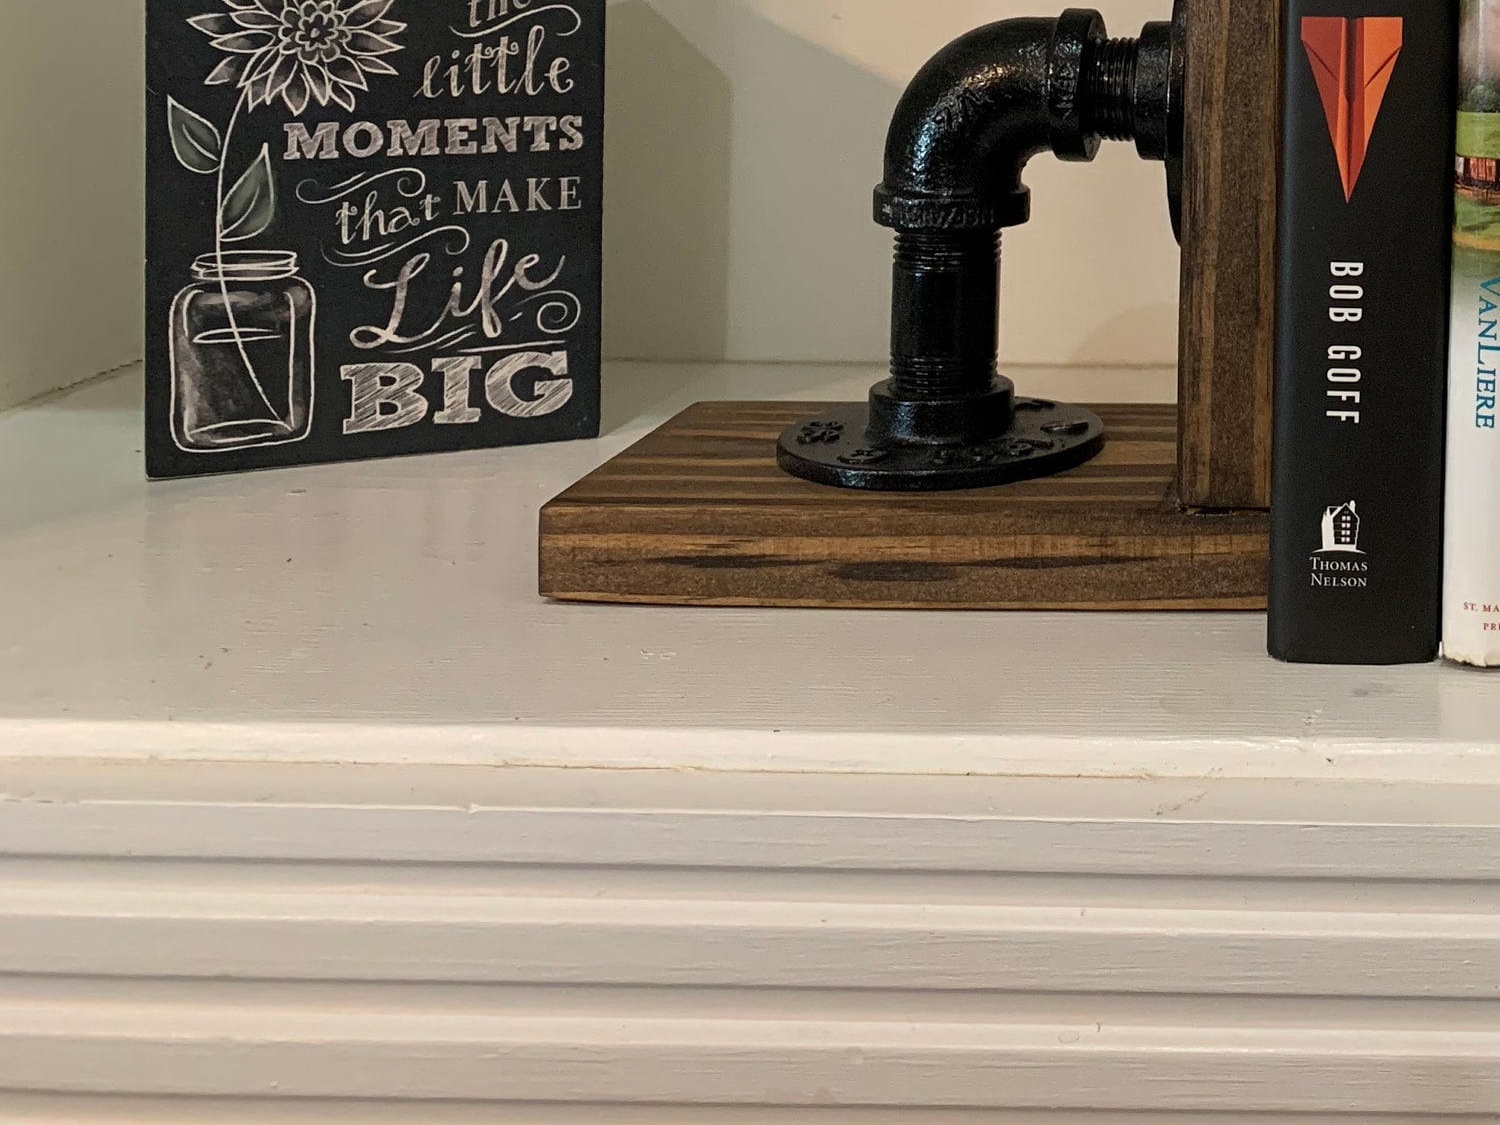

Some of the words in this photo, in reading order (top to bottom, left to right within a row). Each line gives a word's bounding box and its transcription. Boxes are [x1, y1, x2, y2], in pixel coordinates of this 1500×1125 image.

[415, 24, 575, 99] little
[282, 114, 584, 160] MOMENTS
[335, 192, 441, 244] that
[453, 175, 582, 216] MAKE
[349, 238, 566, 349] Life
[1328, 260, 1365, 323] BOB
[339, 349, 574, 435] BIG
[1325, 344, 1363, 425] GOFF
[1462, 601, 1479, 612] ST.
